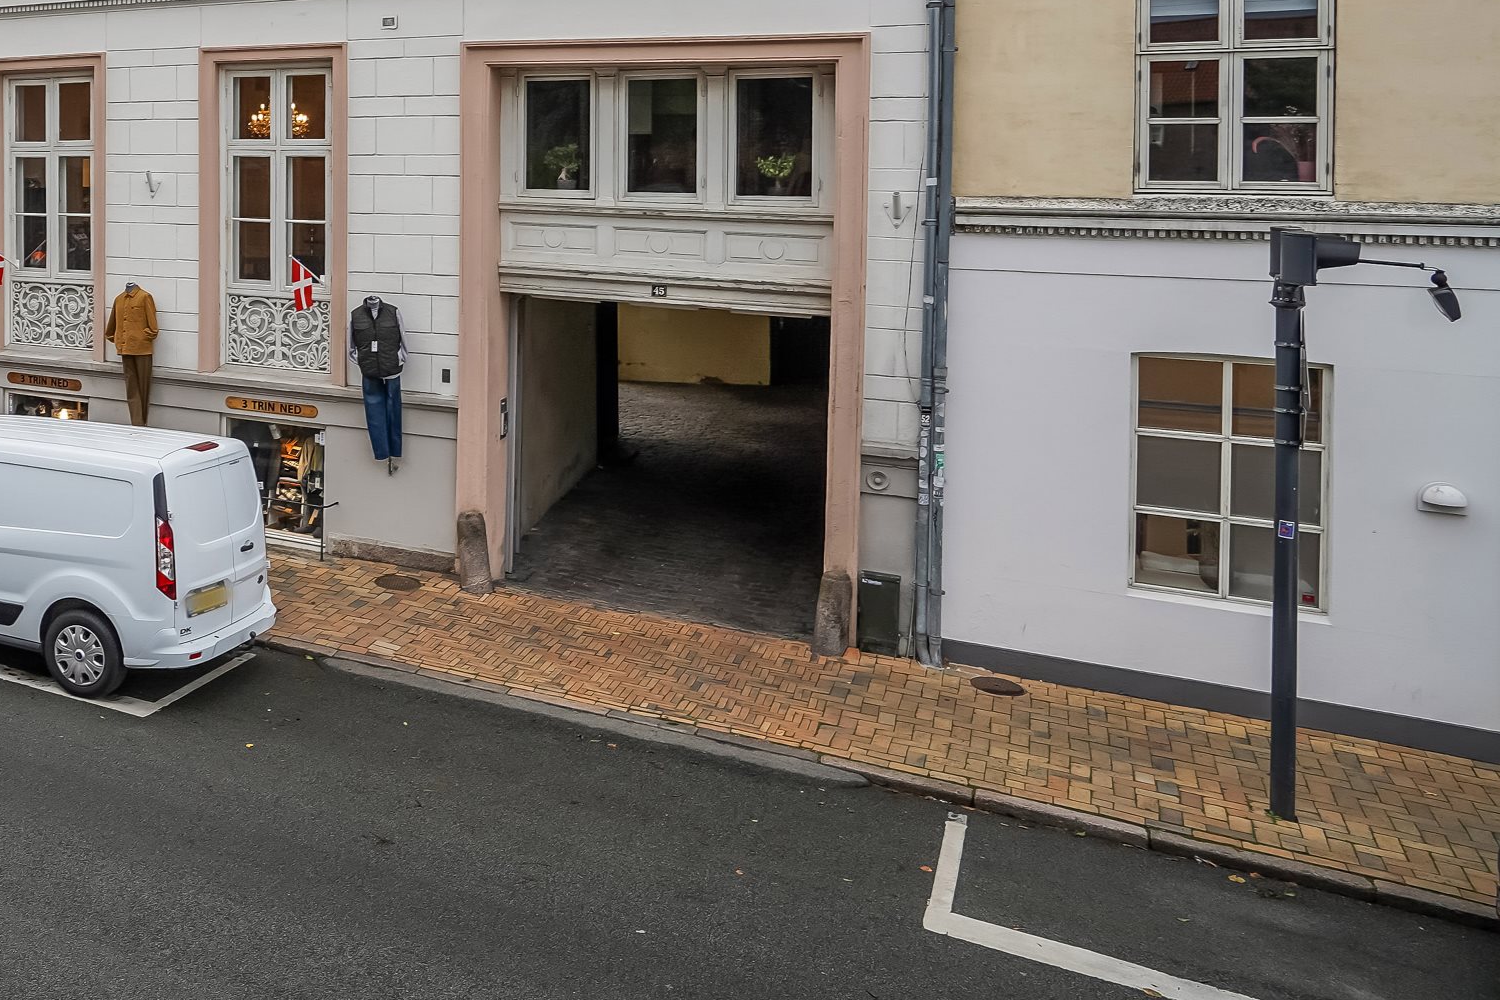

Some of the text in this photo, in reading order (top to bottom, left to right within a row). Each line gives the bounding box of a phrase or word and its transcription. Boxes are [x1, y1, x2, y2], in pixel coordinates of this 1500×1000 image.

[653, 286, 665, 296] 45
[20, 374, 69, 388] 3 TRIN NED
[242, 400, 302, 414] 3 TRIN NED
[921, 414, 930, 423] 52
[180, 626, 192, 634] DK
